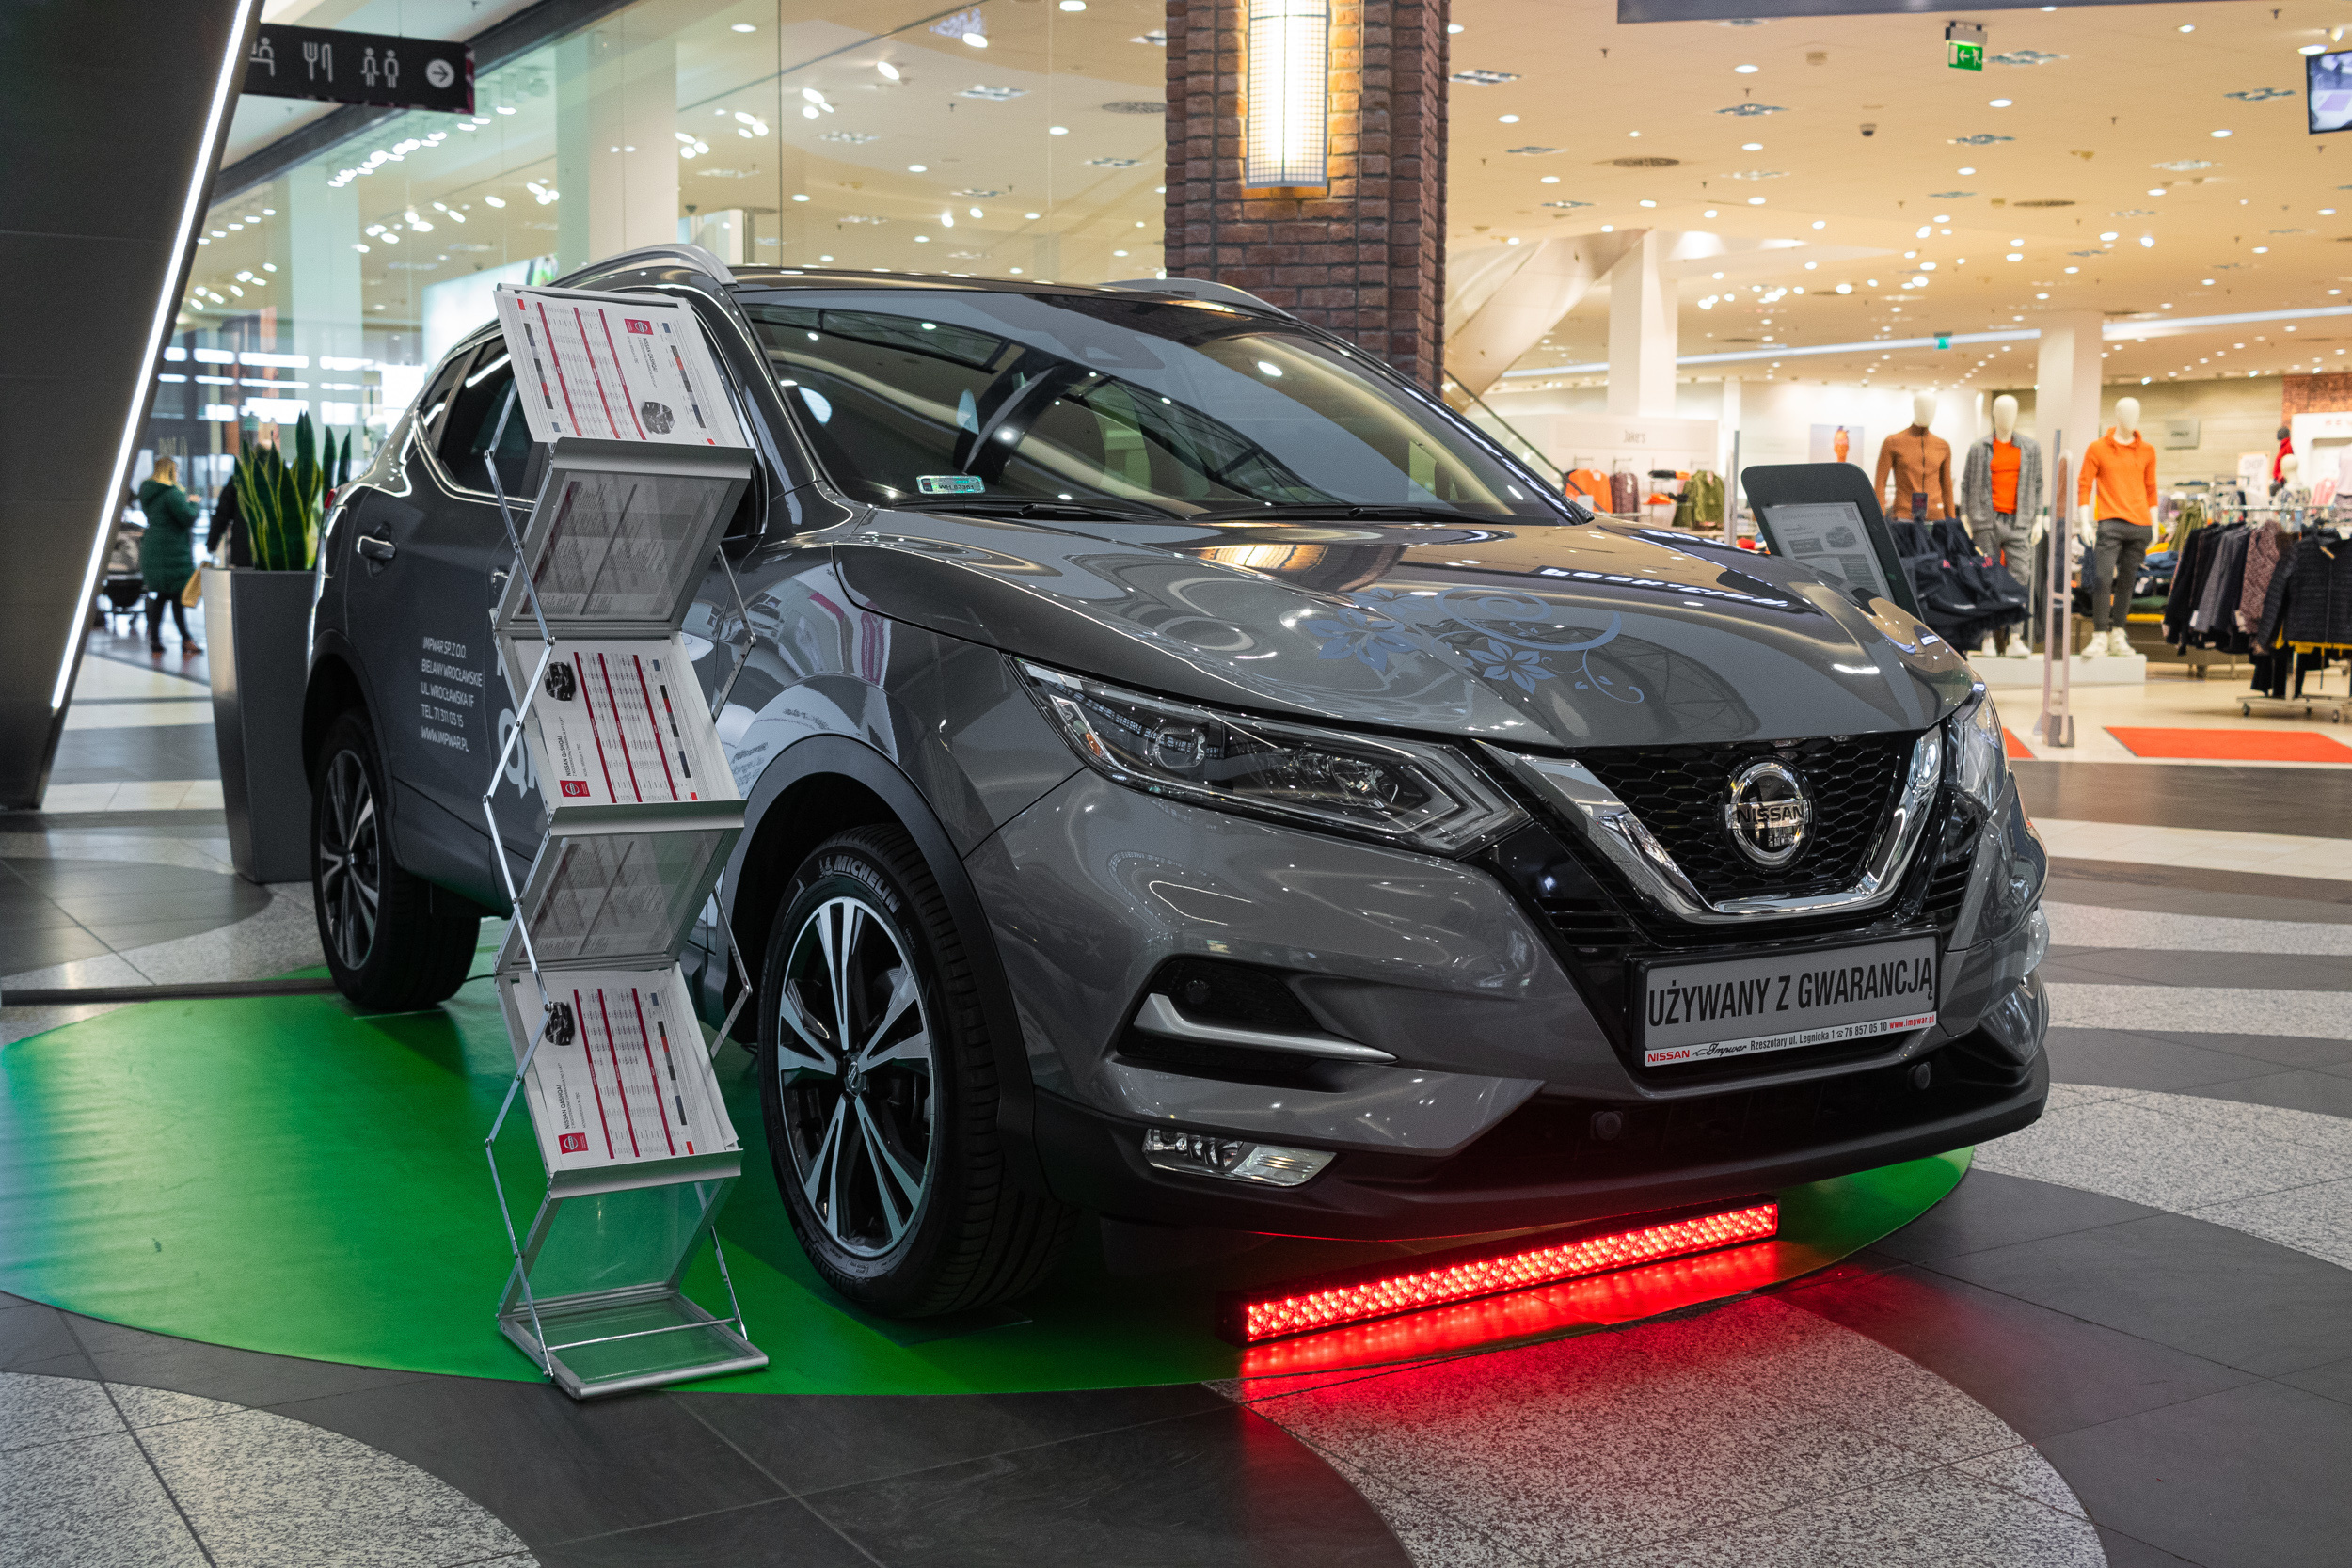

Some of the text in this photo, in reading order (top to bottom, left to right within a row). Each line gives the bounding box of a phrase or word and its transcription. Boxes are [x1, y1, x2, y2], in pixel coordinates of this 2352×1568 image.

[563, 758, 571, 776] NISSAN
[1737, 805, 1804, 824] NISSAN
[834, 855, 901, 914] MICHELIN
[1648, 957, 1934, 1027] UŻYWANY Z GWARANCJĄ
[1647, 1049, 1690, 1063] NISSAN
[1751, 1037, 1788, 1051] Rzeszotary
[1788, 1035, 1798, 1046] ul.
[1800, 1030, 1830, 1044] Legnicka
[1831, 1030, 1835, 1039] 1
[1845, 1026, 1853, 1037] 76
[1855, 1024, 1867, 1036] 857
[1868, 1023, 1878, 1034] 05
[1880, 1022, 1887, 1032] 10
[1889, 1015, 1935, 1030] www.impwar.pl
[557, 1085, 570, 1129] NISSAN QASHQAI
